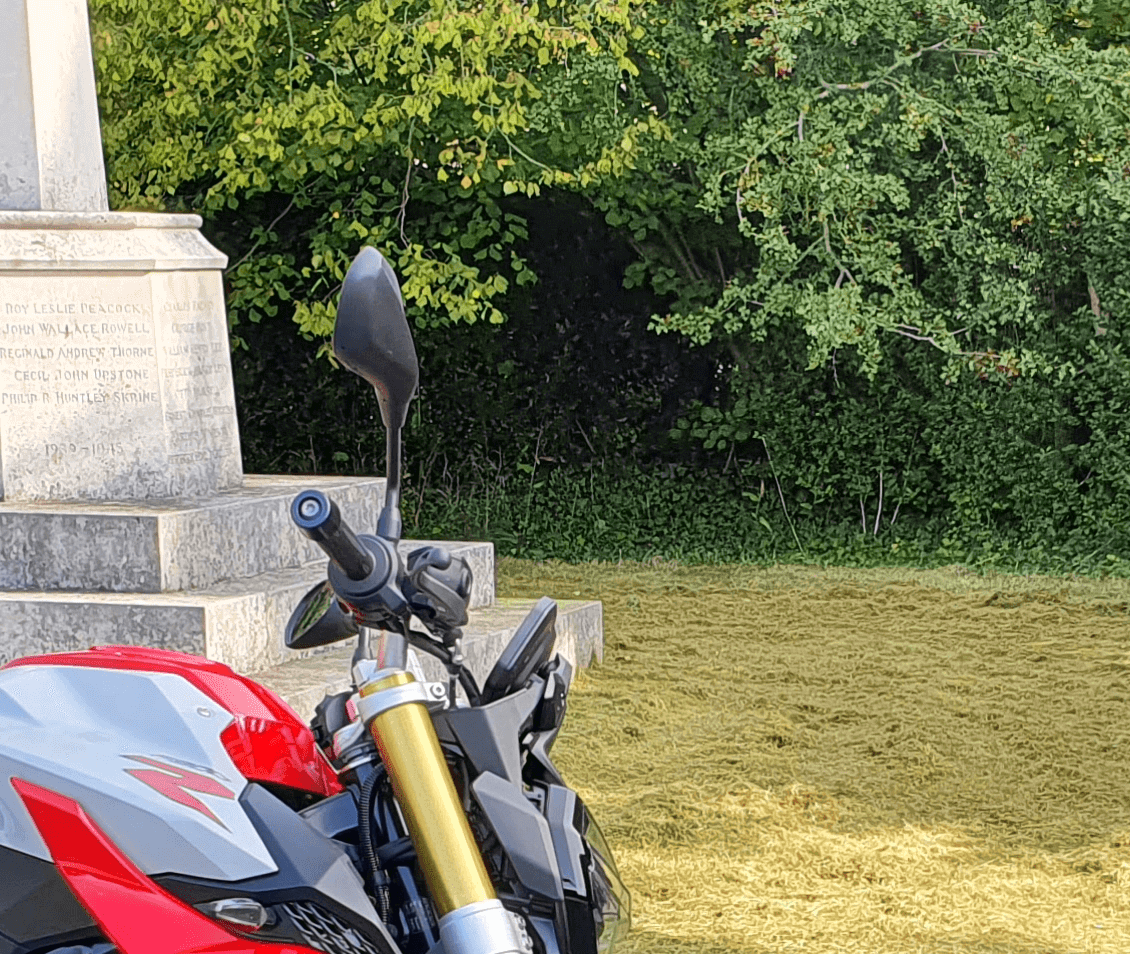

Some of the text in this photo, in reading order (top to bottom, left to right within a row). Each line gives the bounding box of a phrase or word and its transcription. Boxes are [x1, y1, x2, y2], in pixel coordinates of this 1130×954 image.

[5, 303, 141, 314] ROY LESLIE PEACOCK
[2, 322, 149, 337] JOHN WALLACE ROWELL
[0, 347, 54, 359] REGINALD
[58, 347, 106, 359] ANDREW
[110, 346, 153, 358] THORNE
[14, 370, 46, 381] CECIL
[55, 370, 88, 381] JOHN
[56, 391, 107, 403] HUNTLEY
